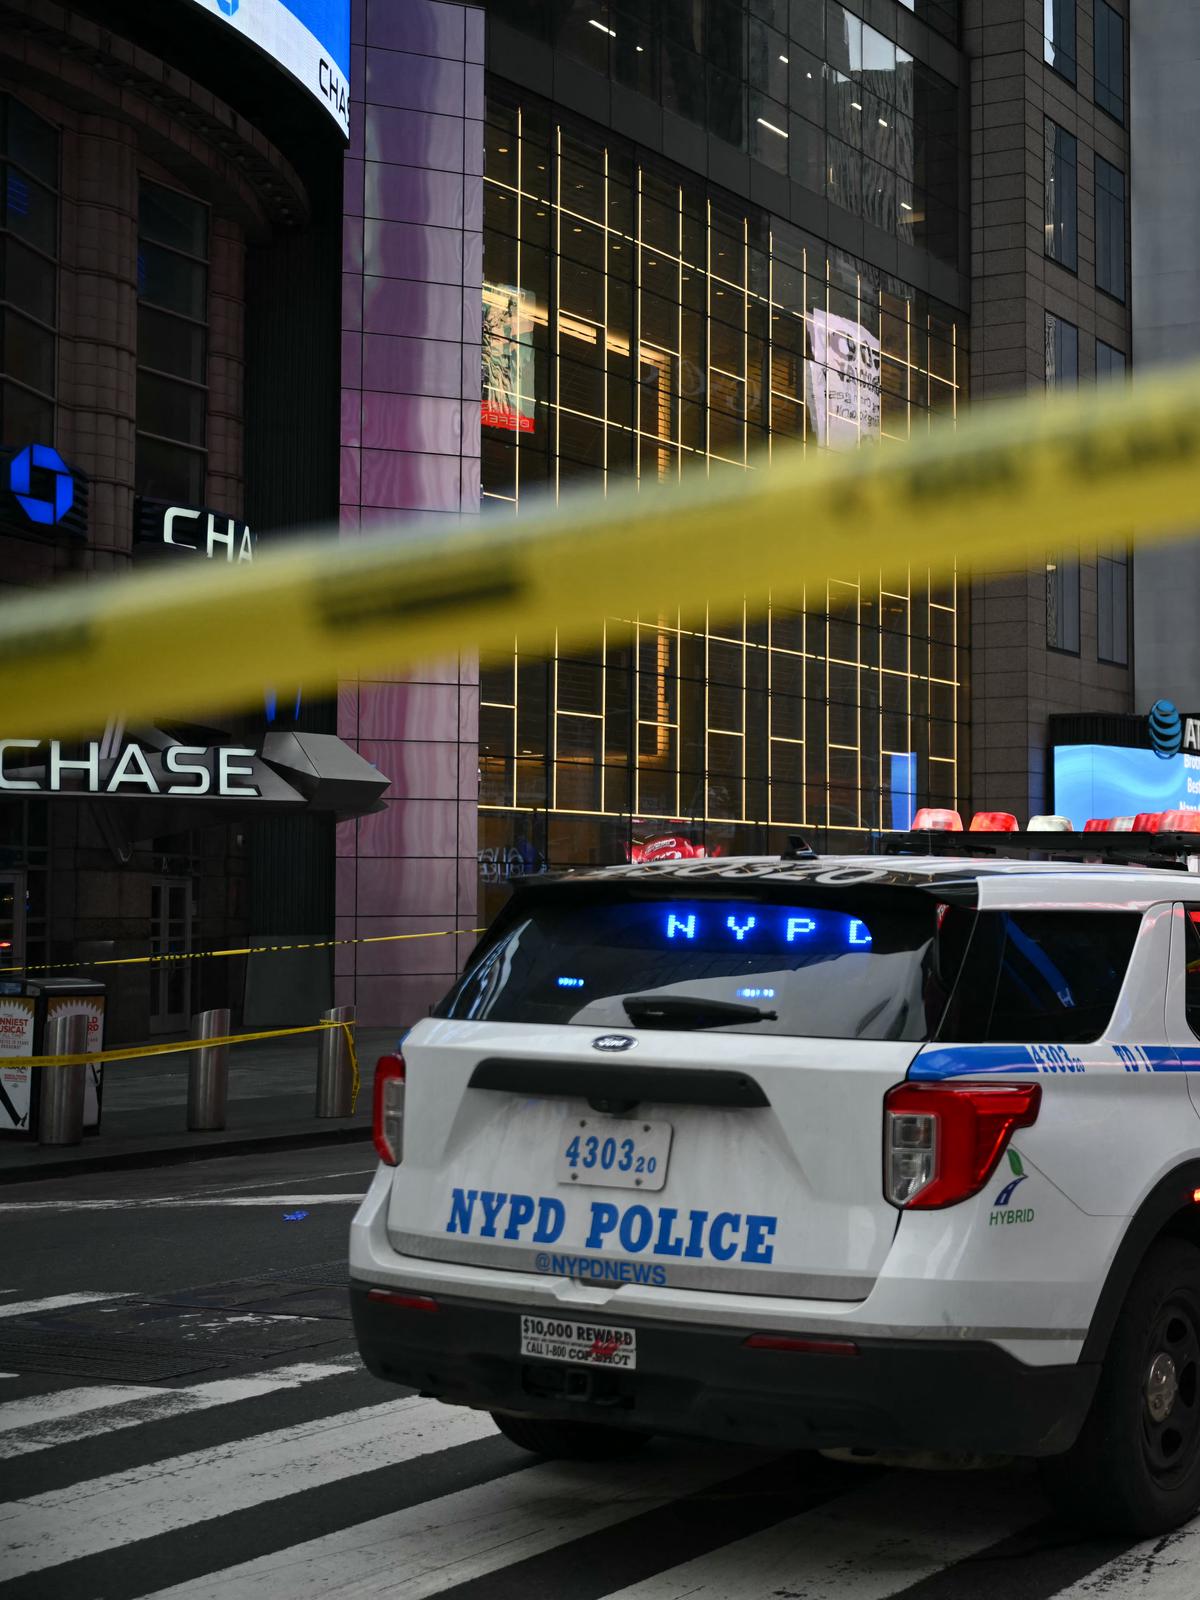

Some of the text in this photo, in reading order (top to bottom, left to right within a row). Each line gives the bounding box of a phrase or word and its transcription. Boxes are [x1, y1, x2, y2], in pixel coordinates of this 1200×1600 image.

[163, 506, 257, 565] CHA
[0, 738, 259, 796] CHASE
[599, 1035, 630, 1049] Ford
[446, 1188, 778, 1264] NYPD POLICE
[988, 1208, 1035, 1226] HYBRID
[535, 1252, 667, 1286] @NYPDNEWS
[523, 1317, 573, 1339] $10,000
[576, 1325, 633, 1346] REWARD
[526, 1341, 544, 1355] CALL
[546, 1345, 567, 1358] 1-800
